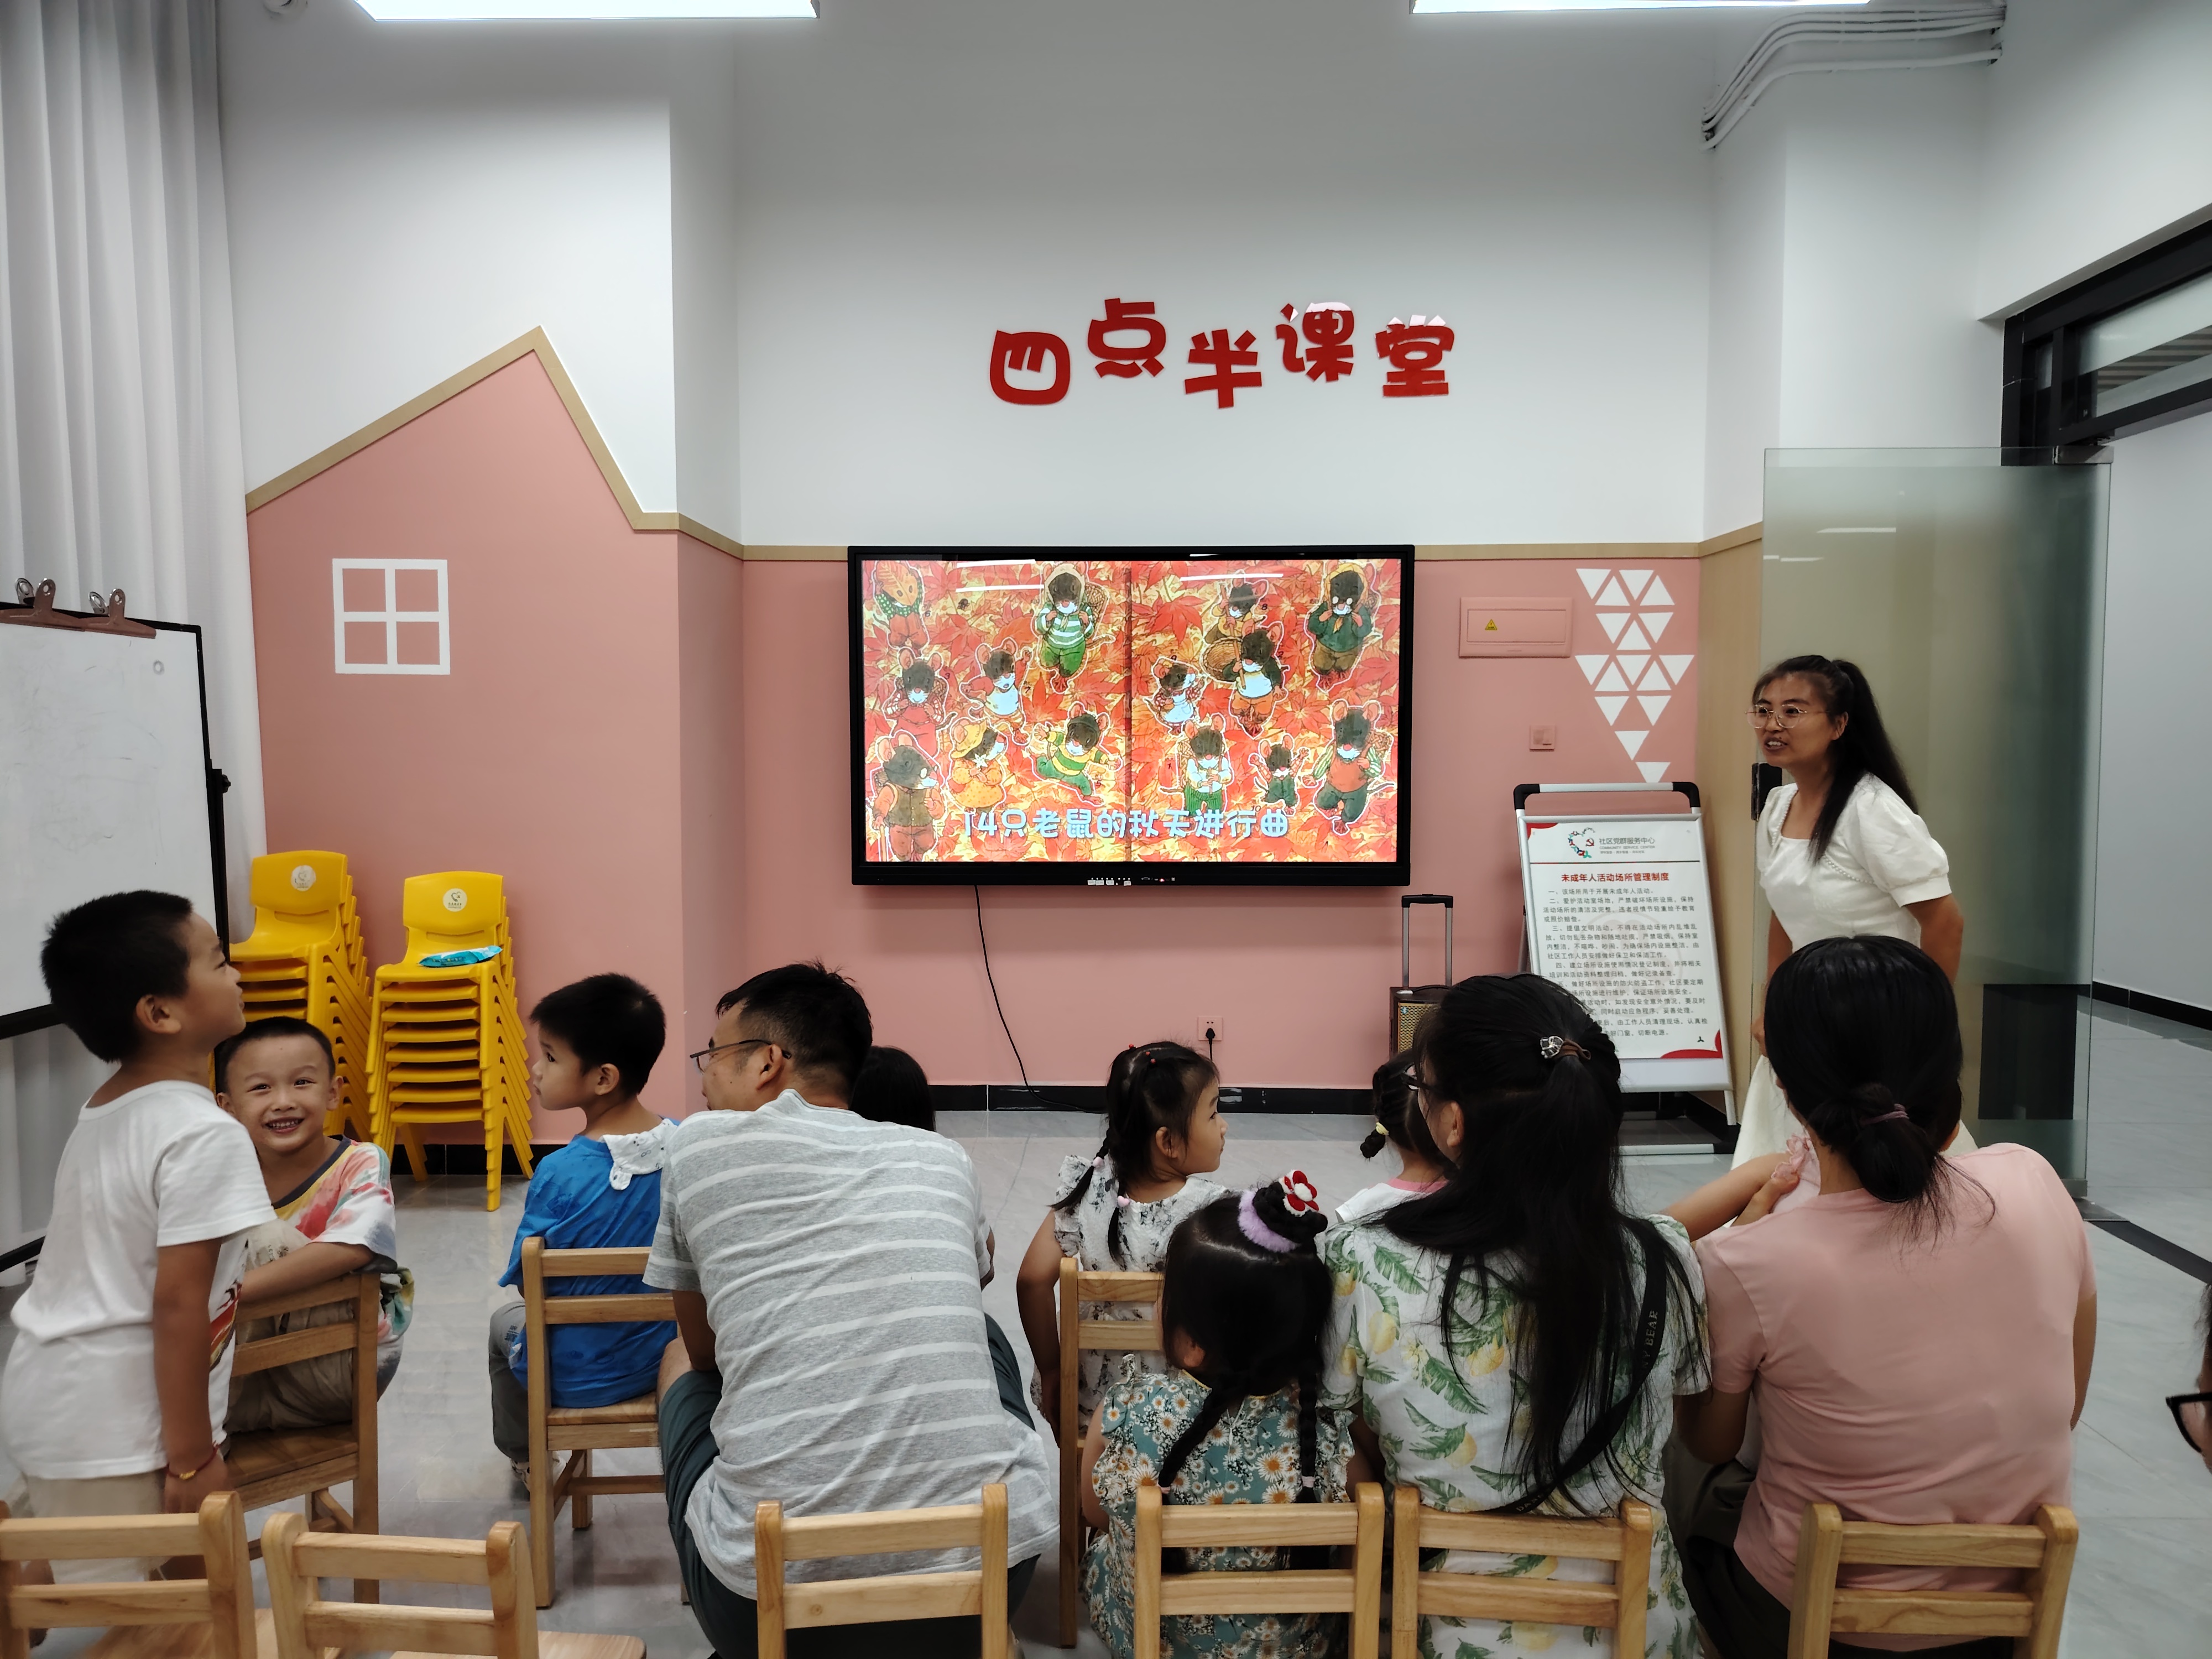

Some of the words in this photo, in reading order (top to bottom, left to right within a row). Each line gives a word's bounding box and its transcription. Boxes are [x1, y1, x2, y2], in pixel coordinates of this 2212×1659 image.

[989, 298, 1455, 409] 四点半课堂
[964, 807, 1289, 838] 14只老鼠的秋天进行曲
[1561, 873, 1670, 882] 未成年人活动场所管理制度
[1645, 1310, 1658, 1346] BEAR
